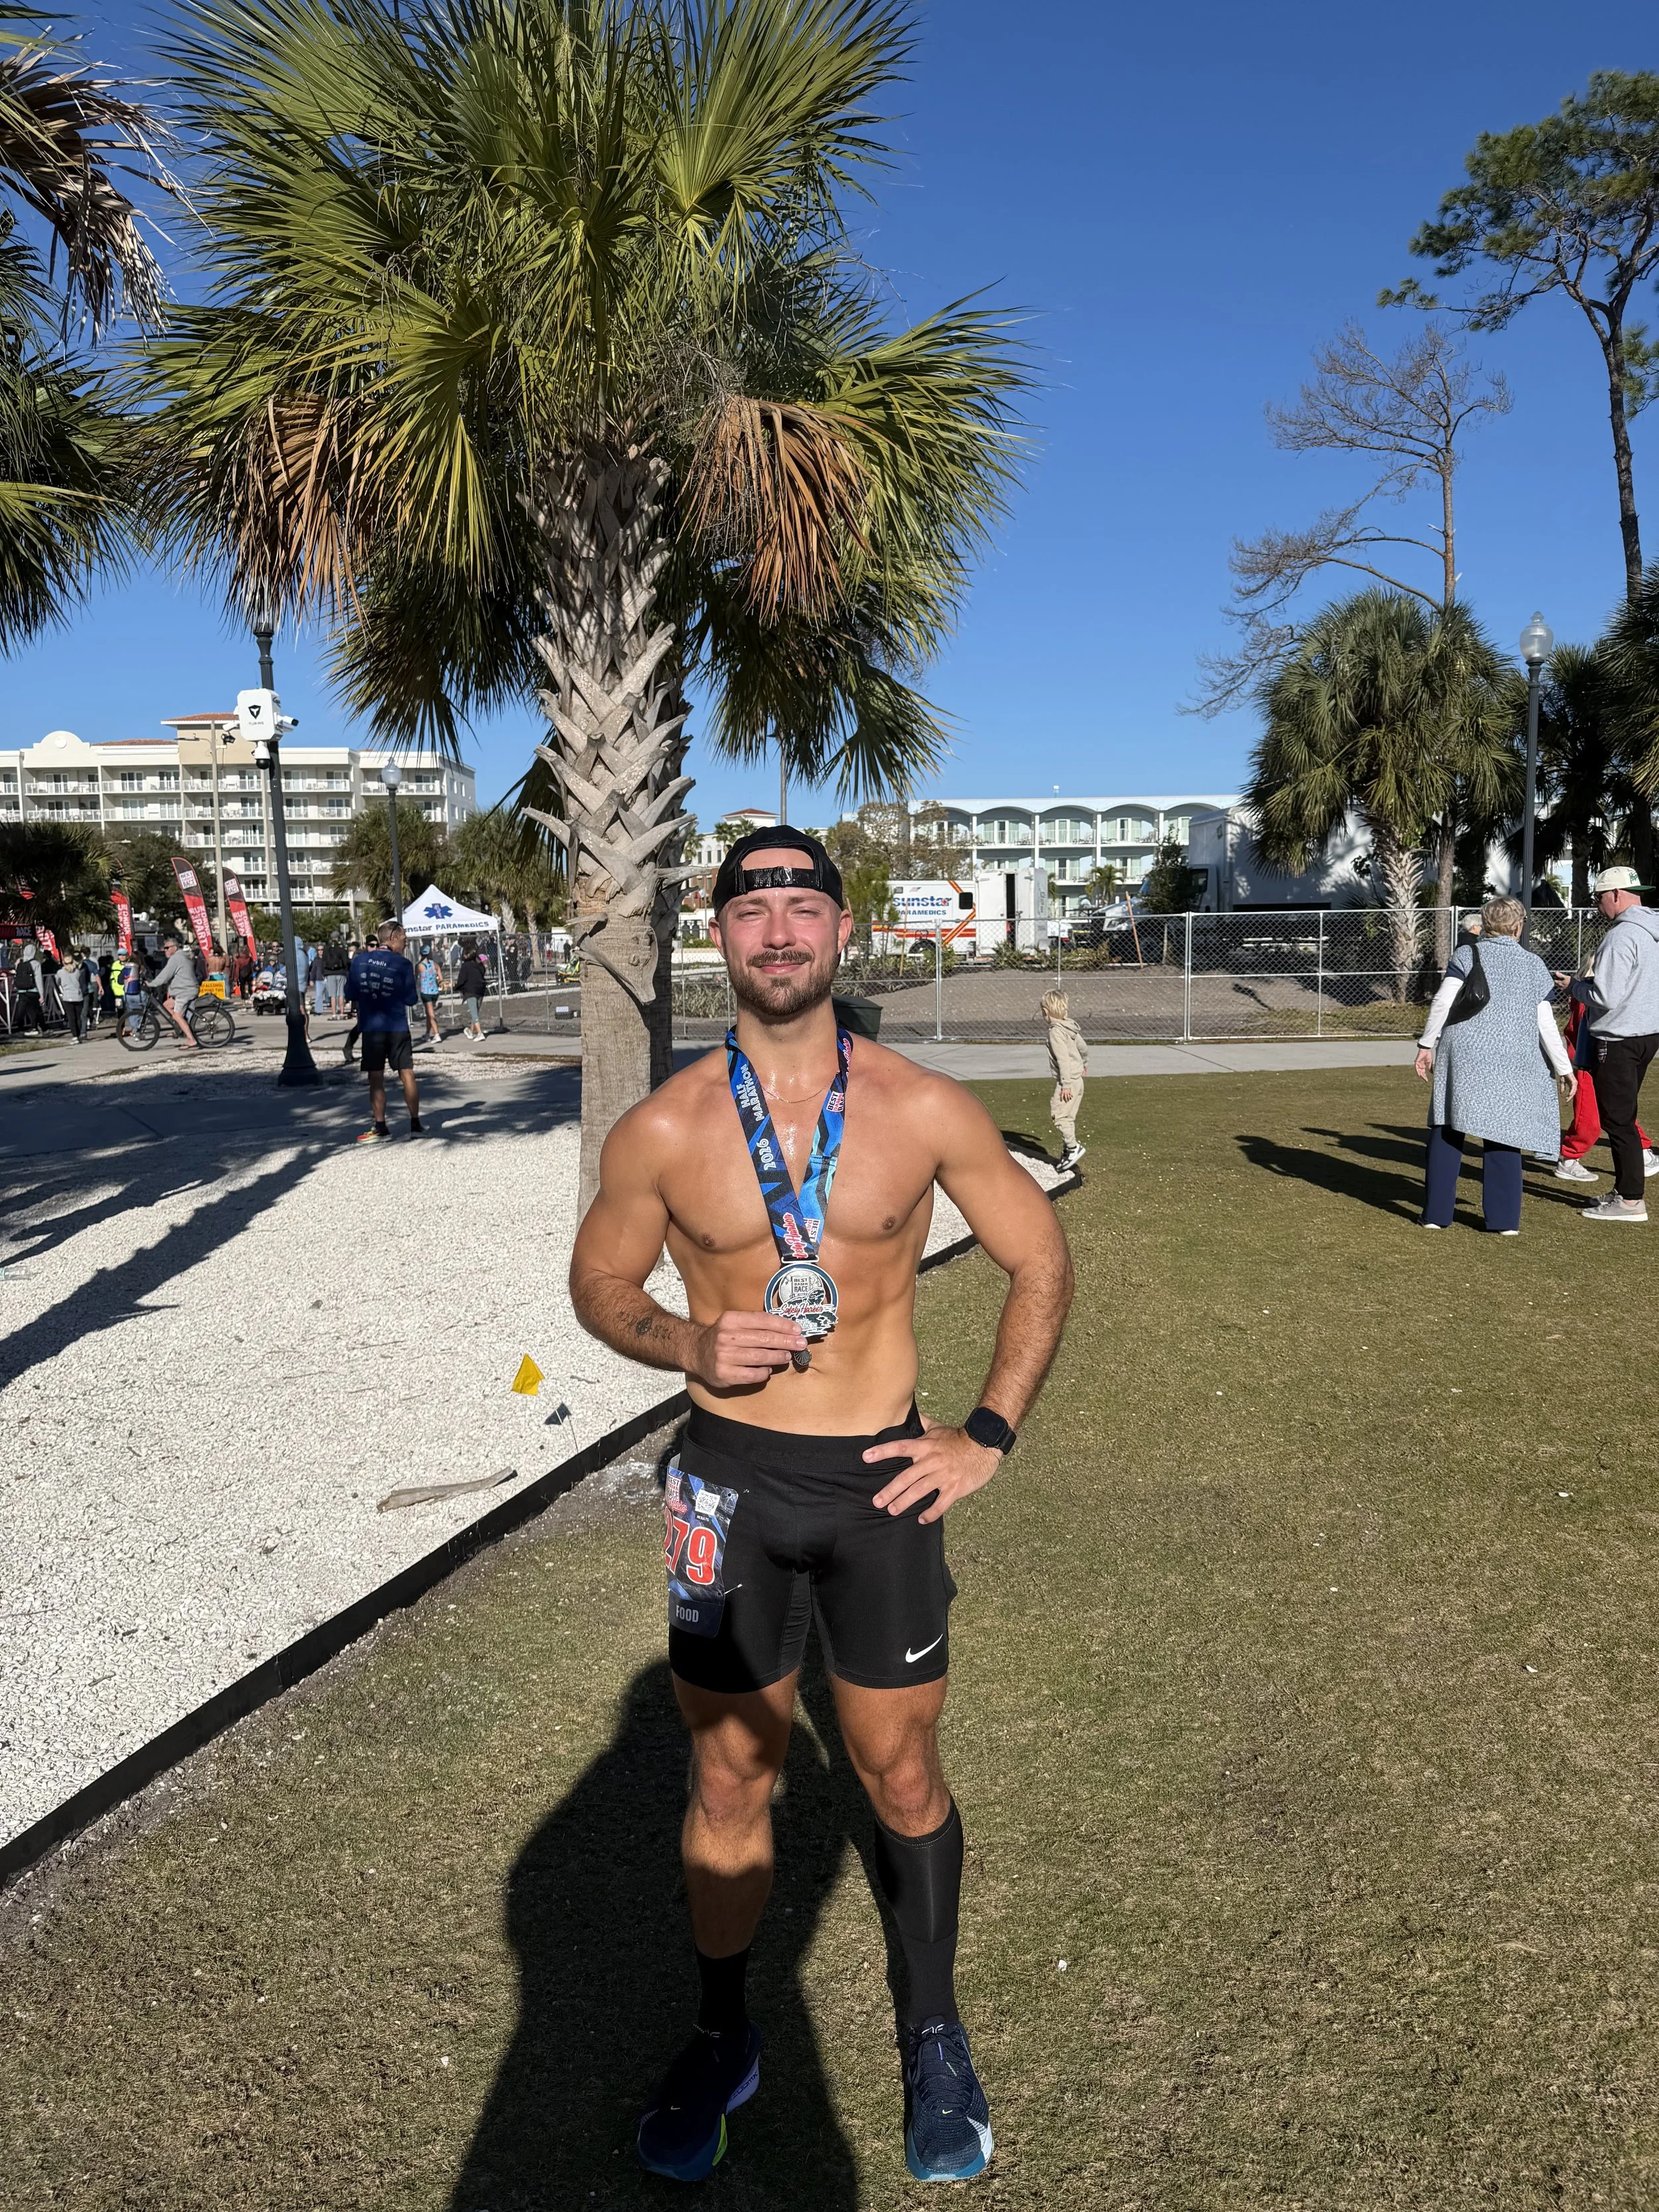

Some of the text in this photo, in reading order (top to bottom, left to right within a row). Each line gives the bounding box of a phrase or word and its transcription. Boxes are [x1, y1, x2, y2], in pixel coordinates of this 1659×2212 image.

[435, 921, 490, 930] PARAMEDICS
[736, 1083, 751, 1108] HALF
[740, 1063, 765, 1122] MARATHON
[828, 1092, 838, 1110] BEST
[756, 1138, 777, 1171] 2026
[810, 1219, 820, 1240] BEST
[676, 1605, 699, 1623] FOOD
